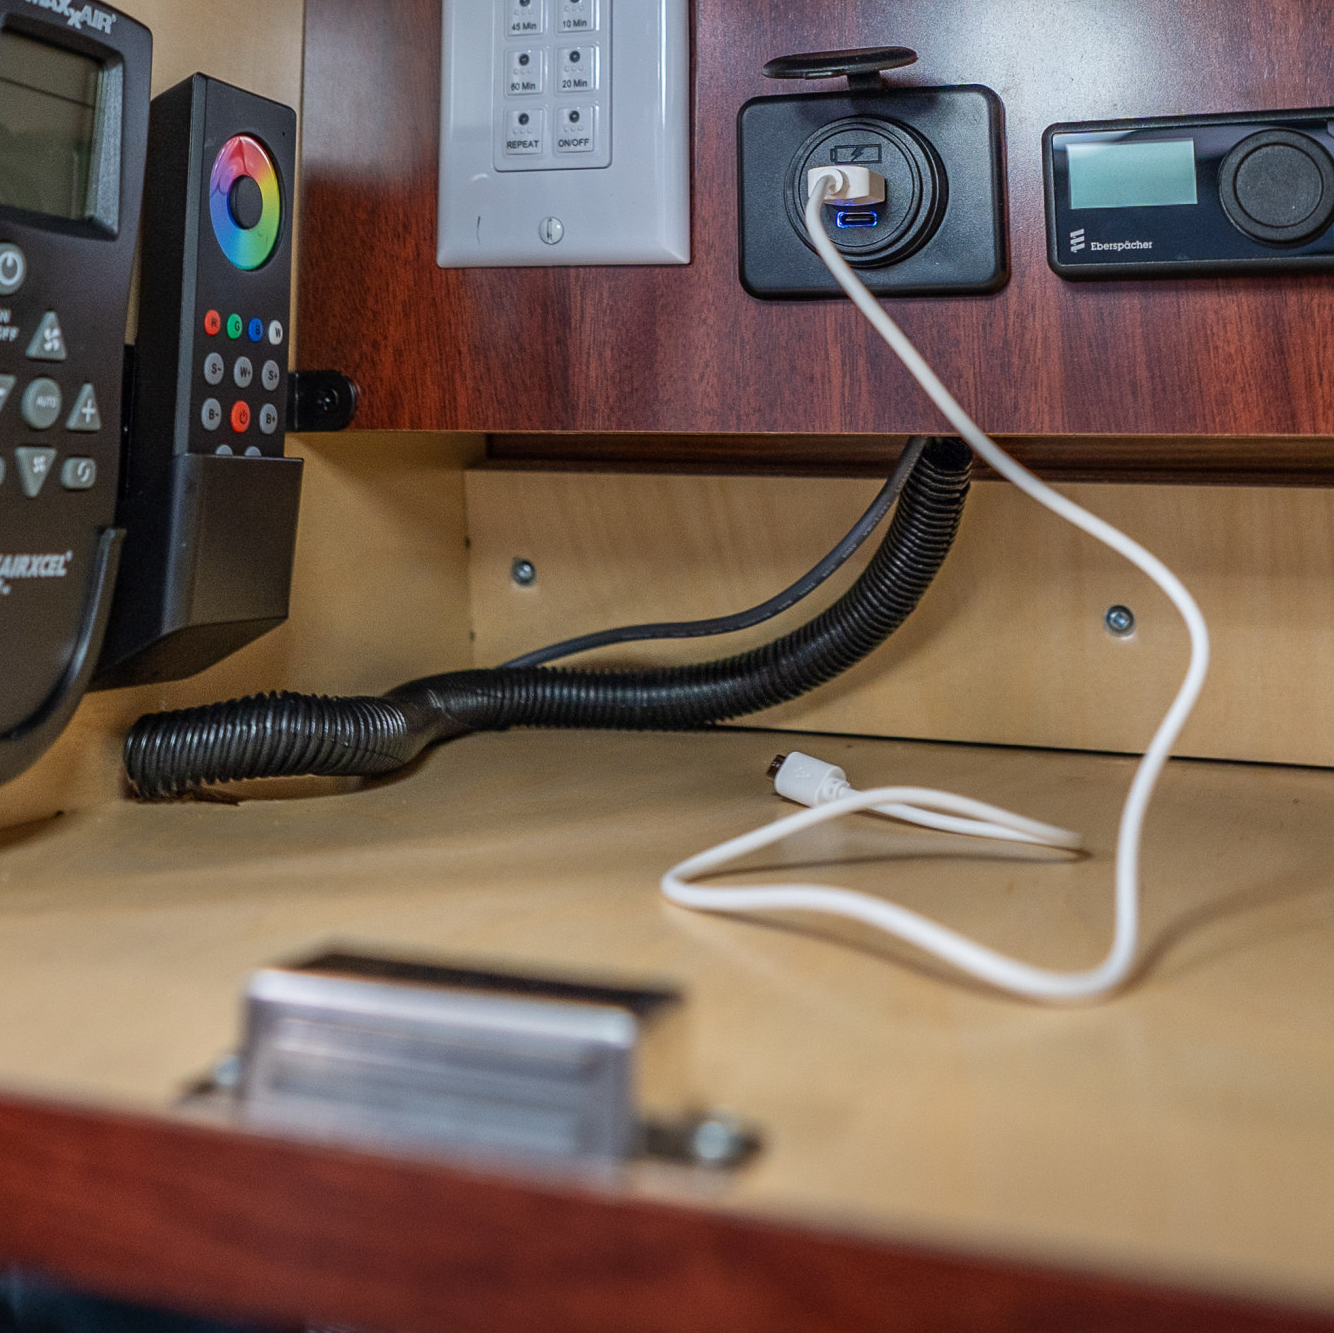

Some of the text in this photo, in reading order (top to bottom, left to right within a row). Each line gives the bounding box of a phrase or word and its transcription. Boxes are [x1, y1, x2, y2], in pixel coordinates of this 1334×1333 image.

[511, 21, 537, 32] 45 Min
[562, 19, 588, 29] 10 Min
[522, 81, 536, 91] Min
[562, 79, 588, 89] 20 Min
[506, 140, 540, 149] REPEAT
[557, 138, 590, 148] ON/OFF
[1090, 240, 1153, 252] Eberspächer
[234, 321, 241, 332] G
[268, 370, 278, 381] S+
[36, 395, 57, 407] AUTO
[265, 413, 276, 424] B+
